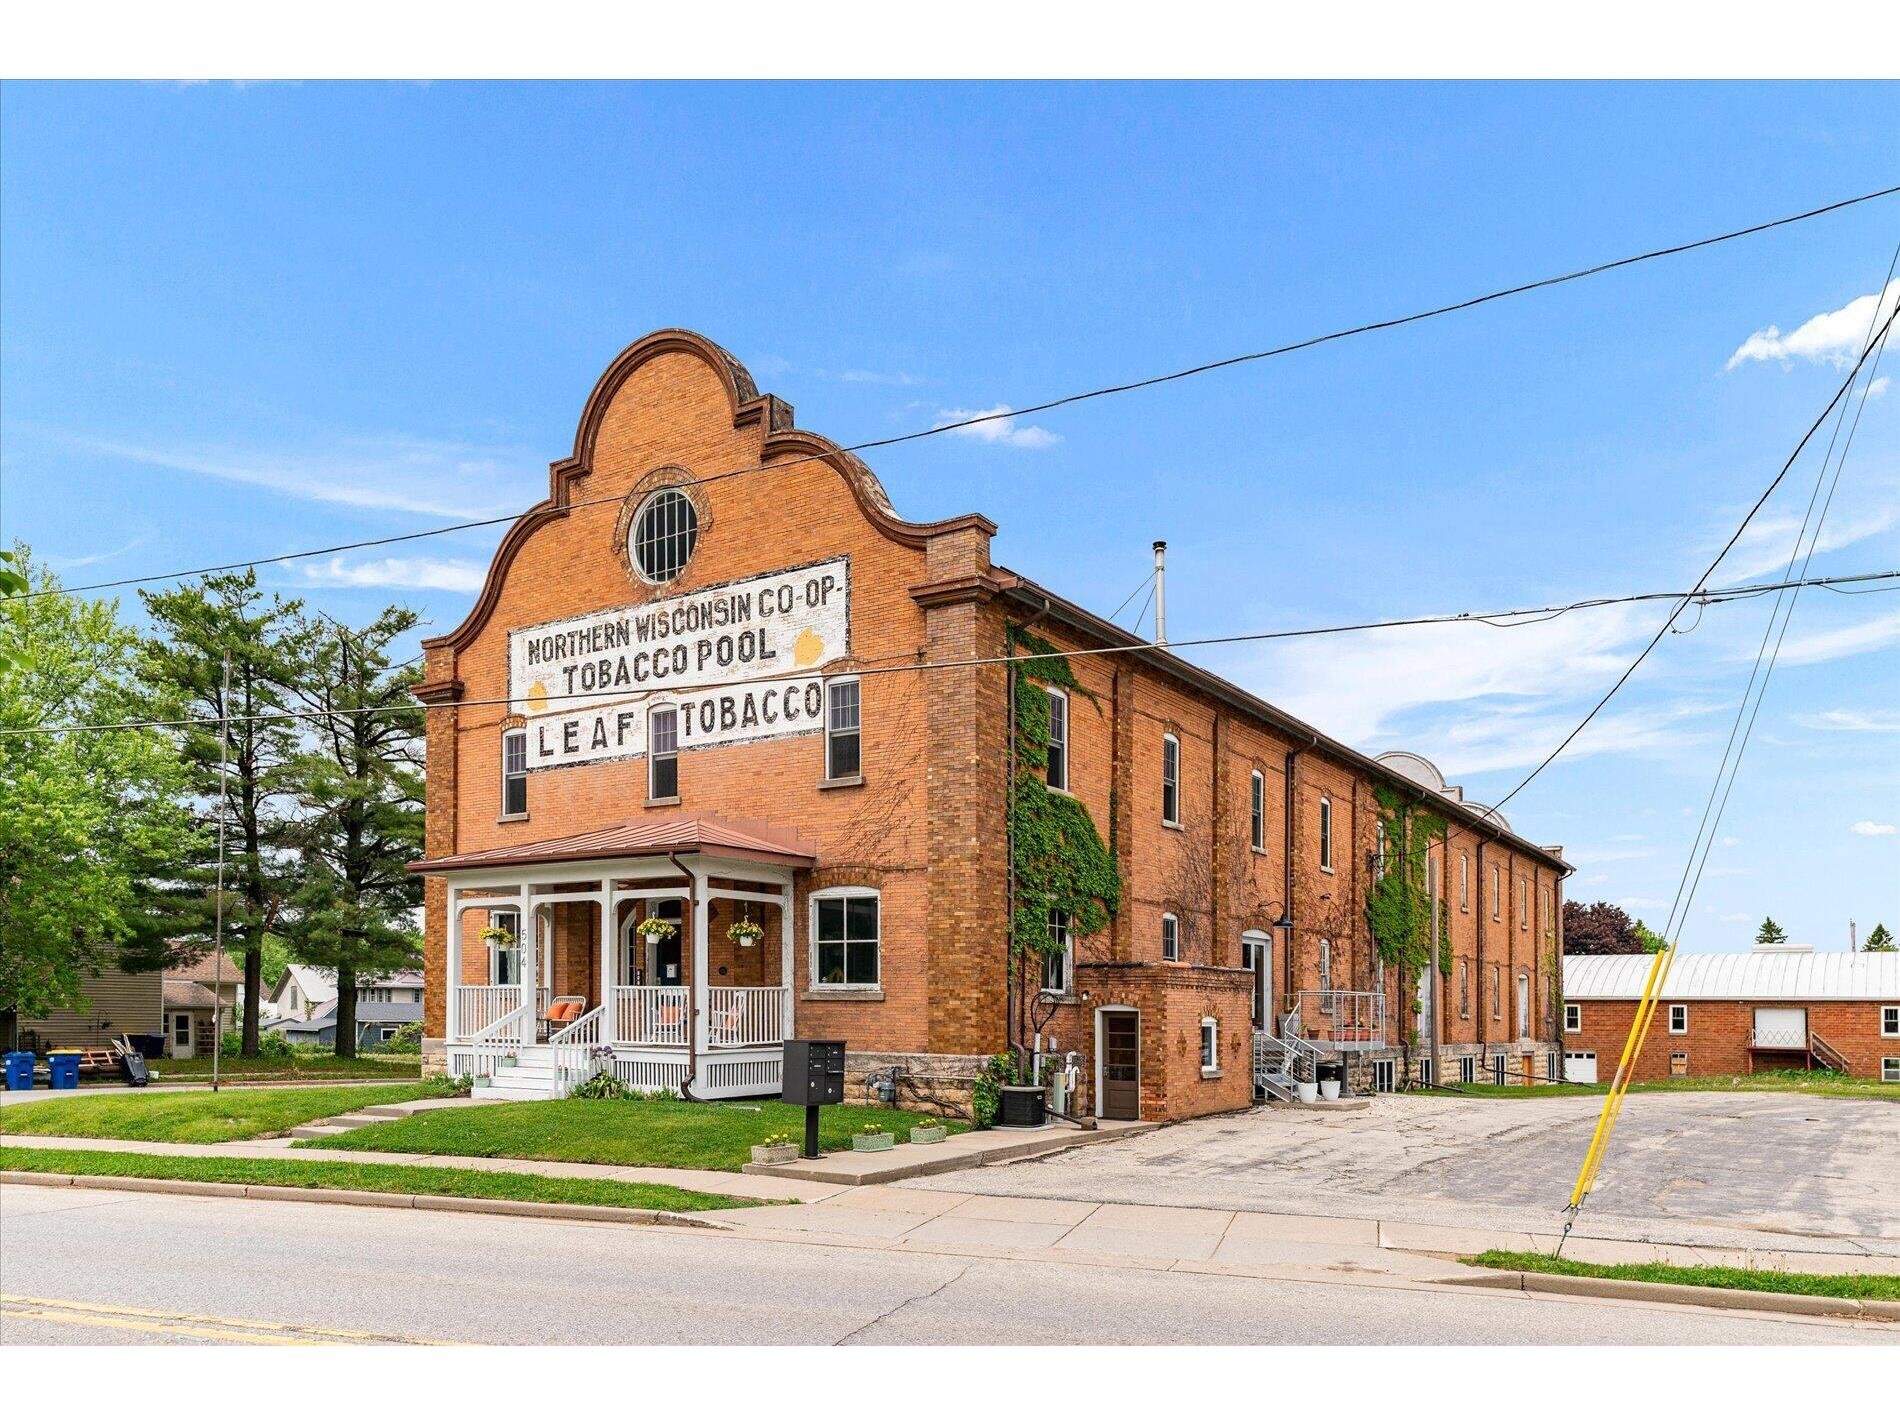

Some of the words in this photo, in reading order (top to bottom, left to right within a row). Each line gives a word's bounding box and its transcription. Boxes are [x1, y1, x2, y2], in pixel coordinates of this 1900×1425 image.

[528, 619, 630, 665] NORTHERN
[635, 593, 751, 643] WISCONSIN
[563, 644, 688, 694] TOBACCO
[697, 627, 777, 671] POOL
[539, 711, 634, 757] LEAF
[680, 682, 822, 737] TOBACCO
